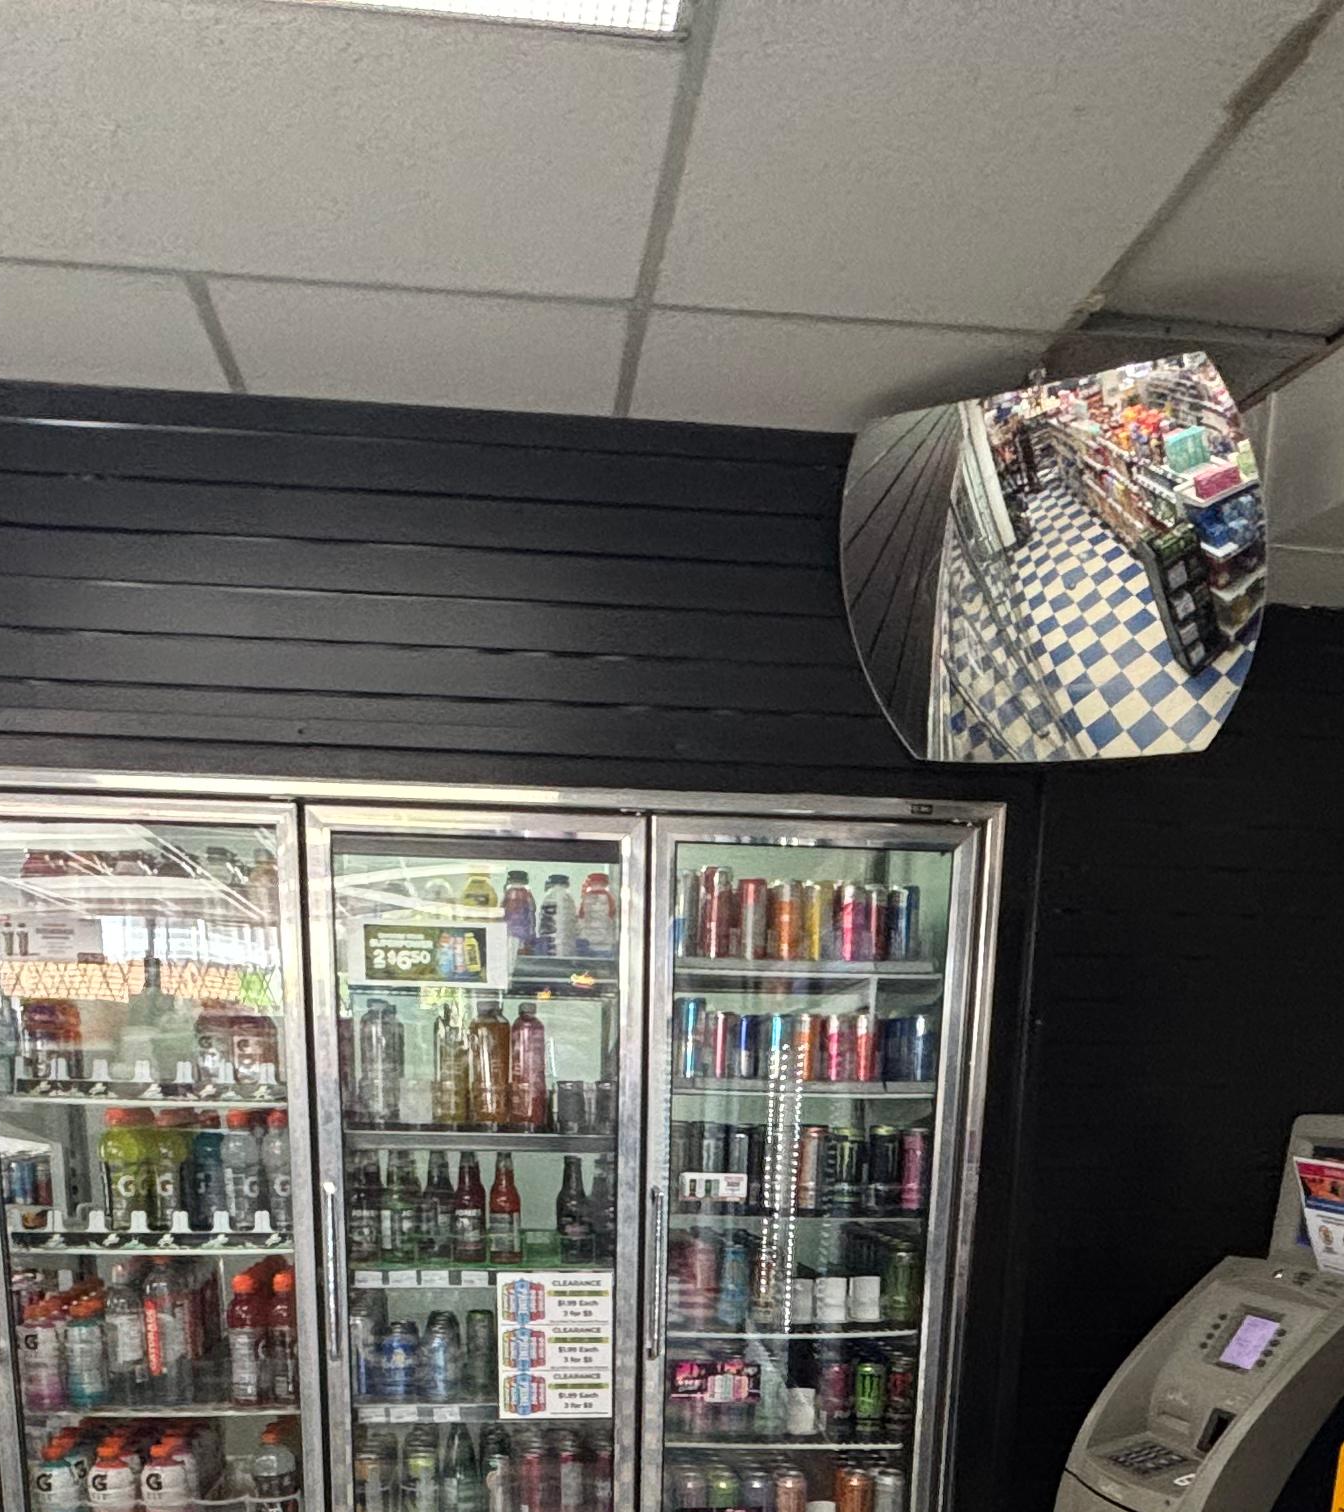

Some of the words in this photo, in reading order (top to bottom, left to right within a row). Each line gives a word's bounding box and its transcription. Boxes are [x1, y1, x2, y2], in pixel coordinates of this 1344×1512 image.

[37, 1473, 53, 1493] G
[92, 1474, 107, 1492] G
[146, 1472, 163, 1491] G
